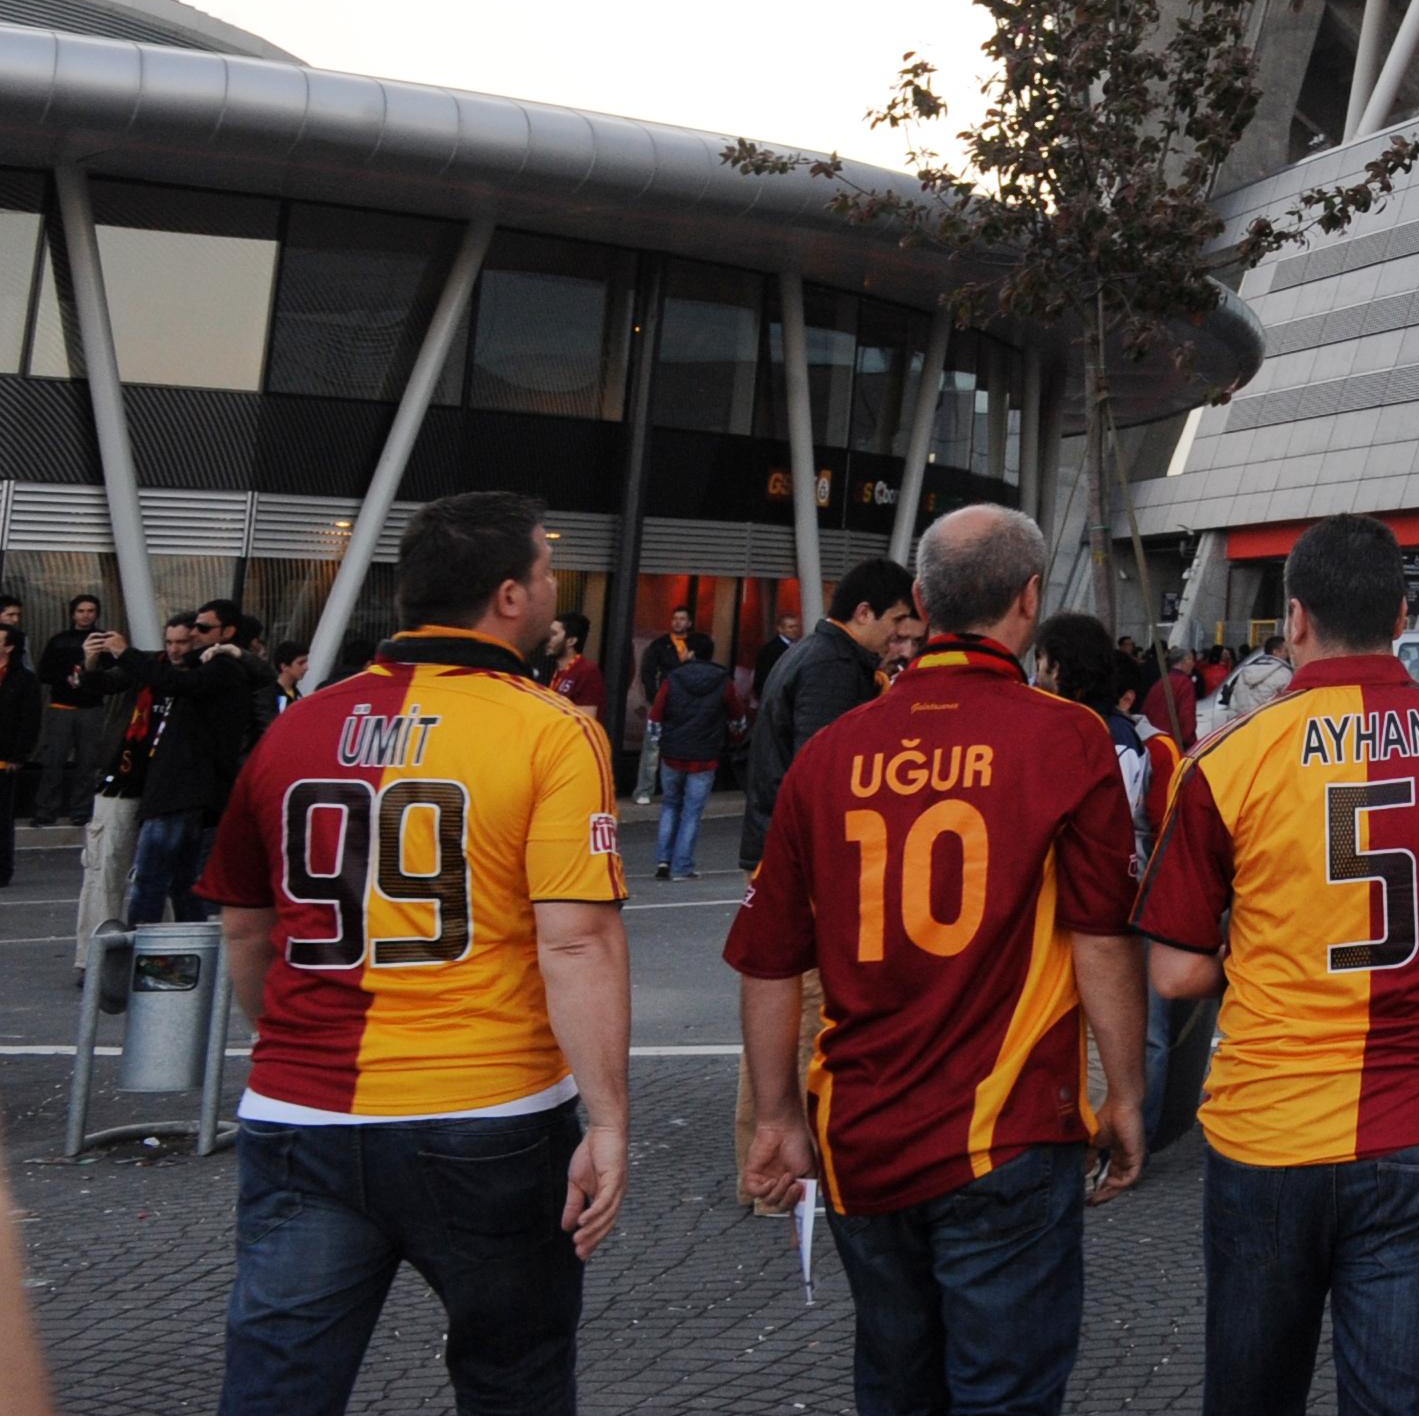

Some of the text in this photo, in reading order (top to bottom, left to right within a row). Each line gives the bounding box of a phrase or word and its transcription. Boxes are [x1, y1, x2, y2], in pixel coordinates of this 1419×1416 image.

[337, 703, 442, 768] ÜMİT
[850, 738, 994, 798] UĞUR
[282, 778, 474, 970] 99
[845, 799, 989, 962] 10
[1325, 776, 1419, 974] 5
